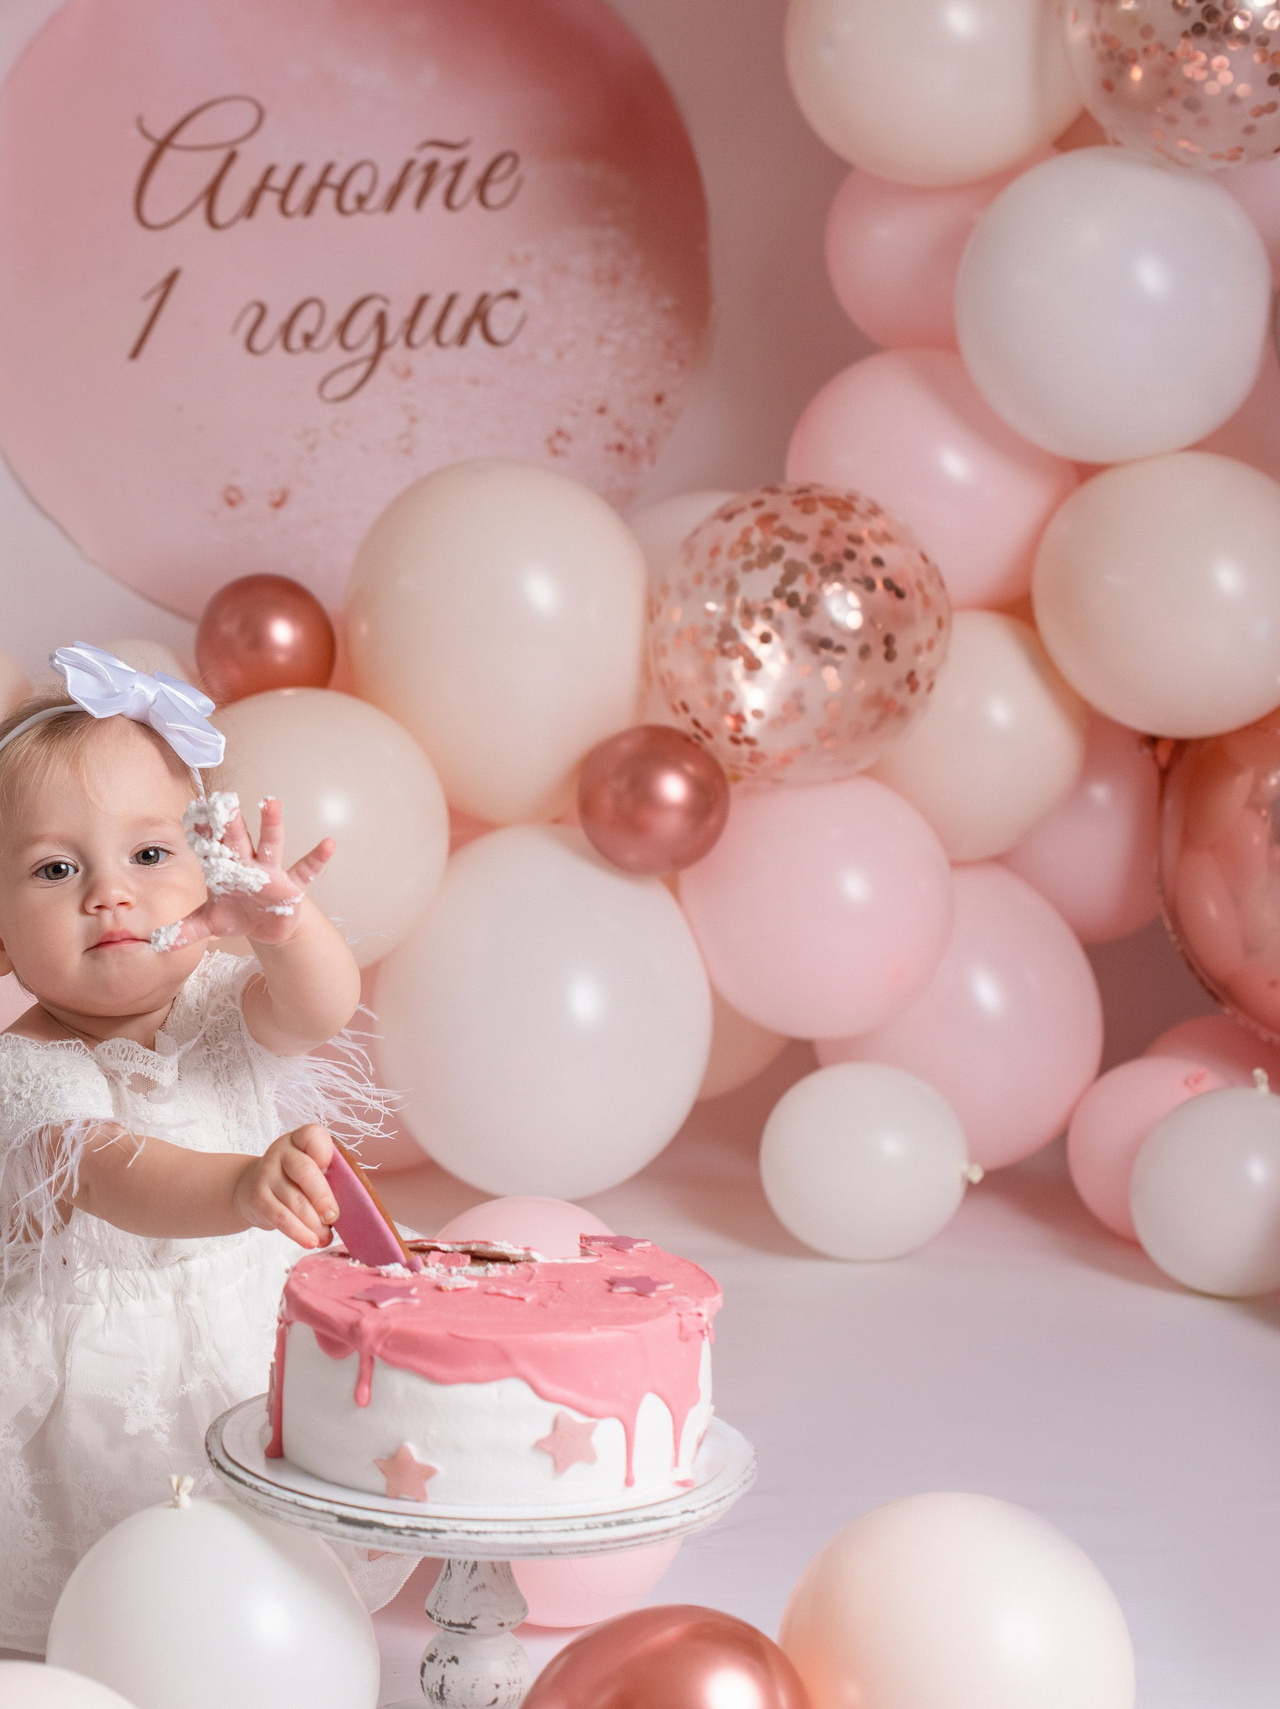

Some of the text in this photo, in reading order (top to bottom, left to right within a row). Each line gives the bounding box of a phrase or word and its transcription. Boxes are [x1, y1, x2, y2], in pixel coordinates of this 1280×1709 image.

[134, 94, 524, 231] Анюте
[126, 265, 528, 404] 1 годик
